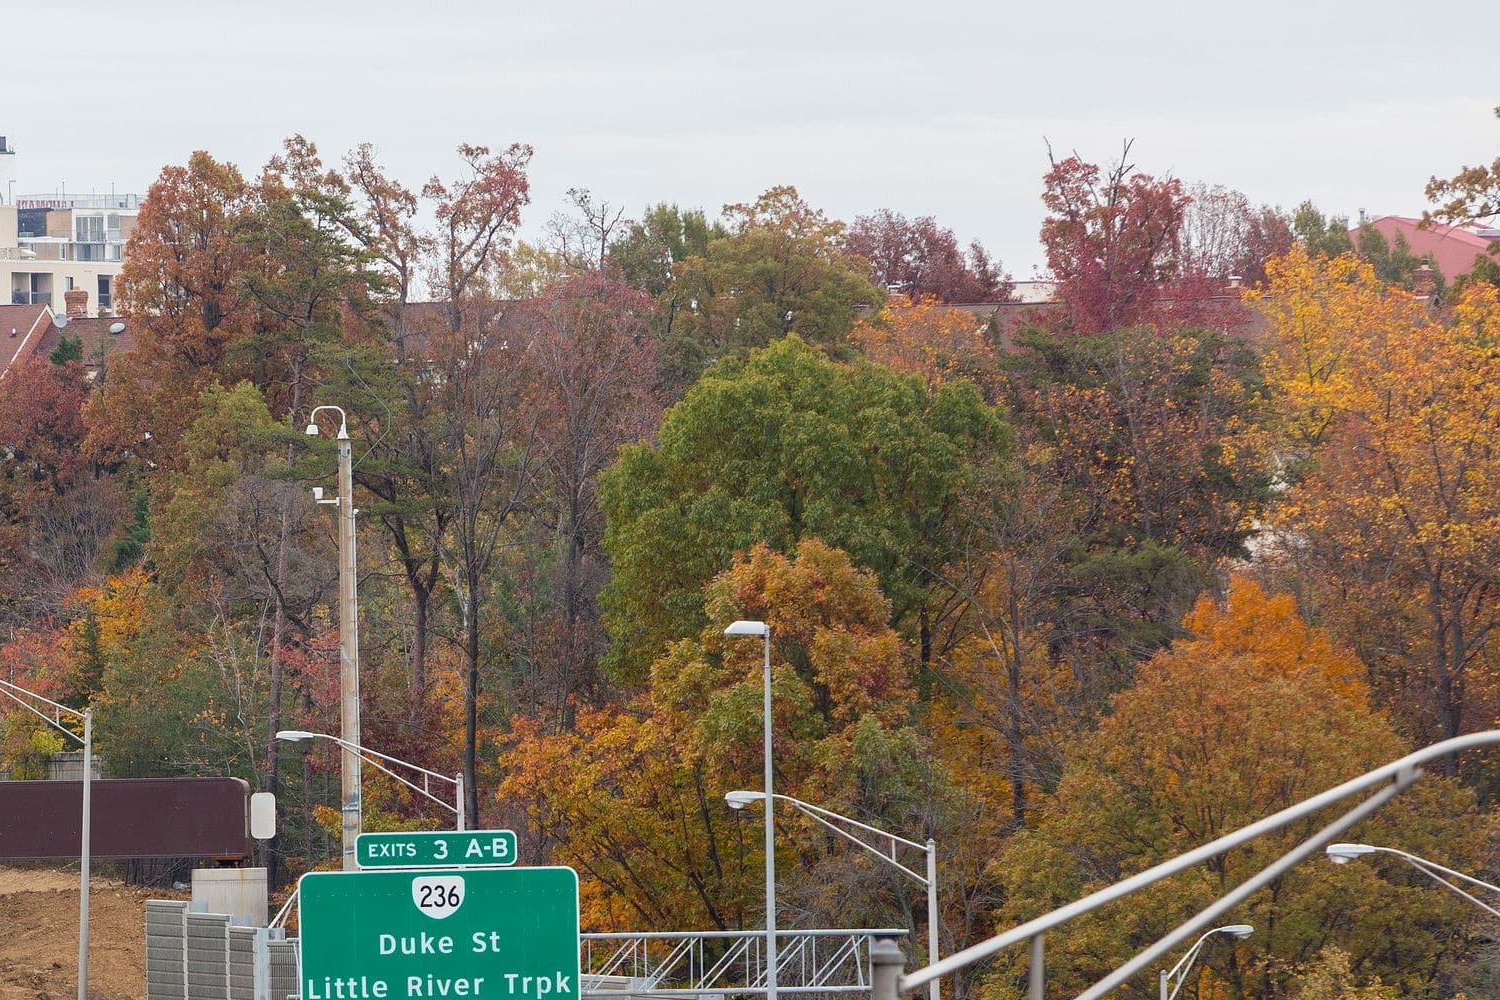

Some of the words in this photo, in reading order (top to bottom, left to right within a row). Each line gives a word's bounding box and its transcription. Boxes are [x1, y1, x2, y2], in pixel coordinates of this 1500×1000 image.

[368, 843, 417, 858] EXITS
[433, 839, 448, 860] 3
[465, 838, 508, 858] A-B
[419, 885, 460, 908] 236
[379, 932, 454, 956] Duke
[472, 931, 501, 953] St
[308, 976, 388, 1000] Little
[407, 974, 485, 998] River
[504, 971, 571, 999] Trpk
